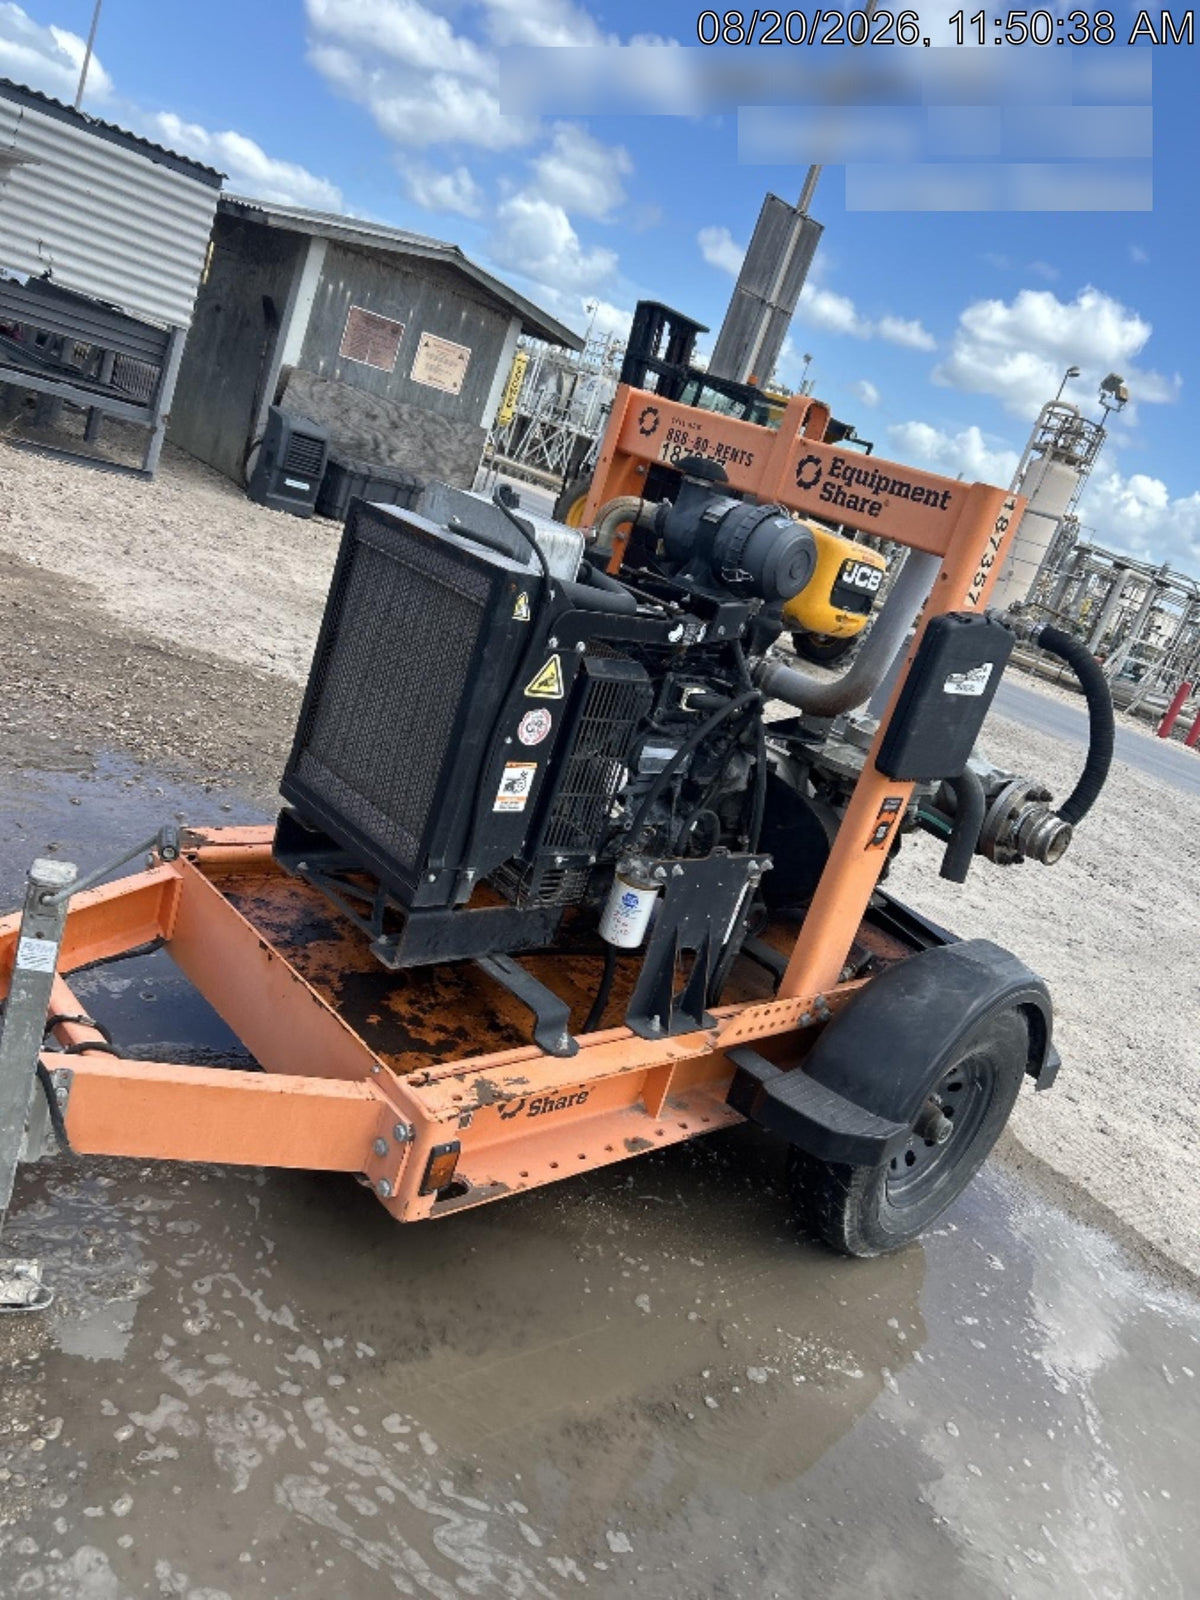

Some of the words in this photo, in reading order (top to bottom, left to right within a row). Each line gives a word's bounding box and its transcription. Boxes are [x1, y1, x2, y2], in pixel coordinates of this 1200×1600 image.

[828, 456, 952, 511] Equipment
[842, 563, 883, 592] JCB
[968, 499, 1016, 605] 187357
